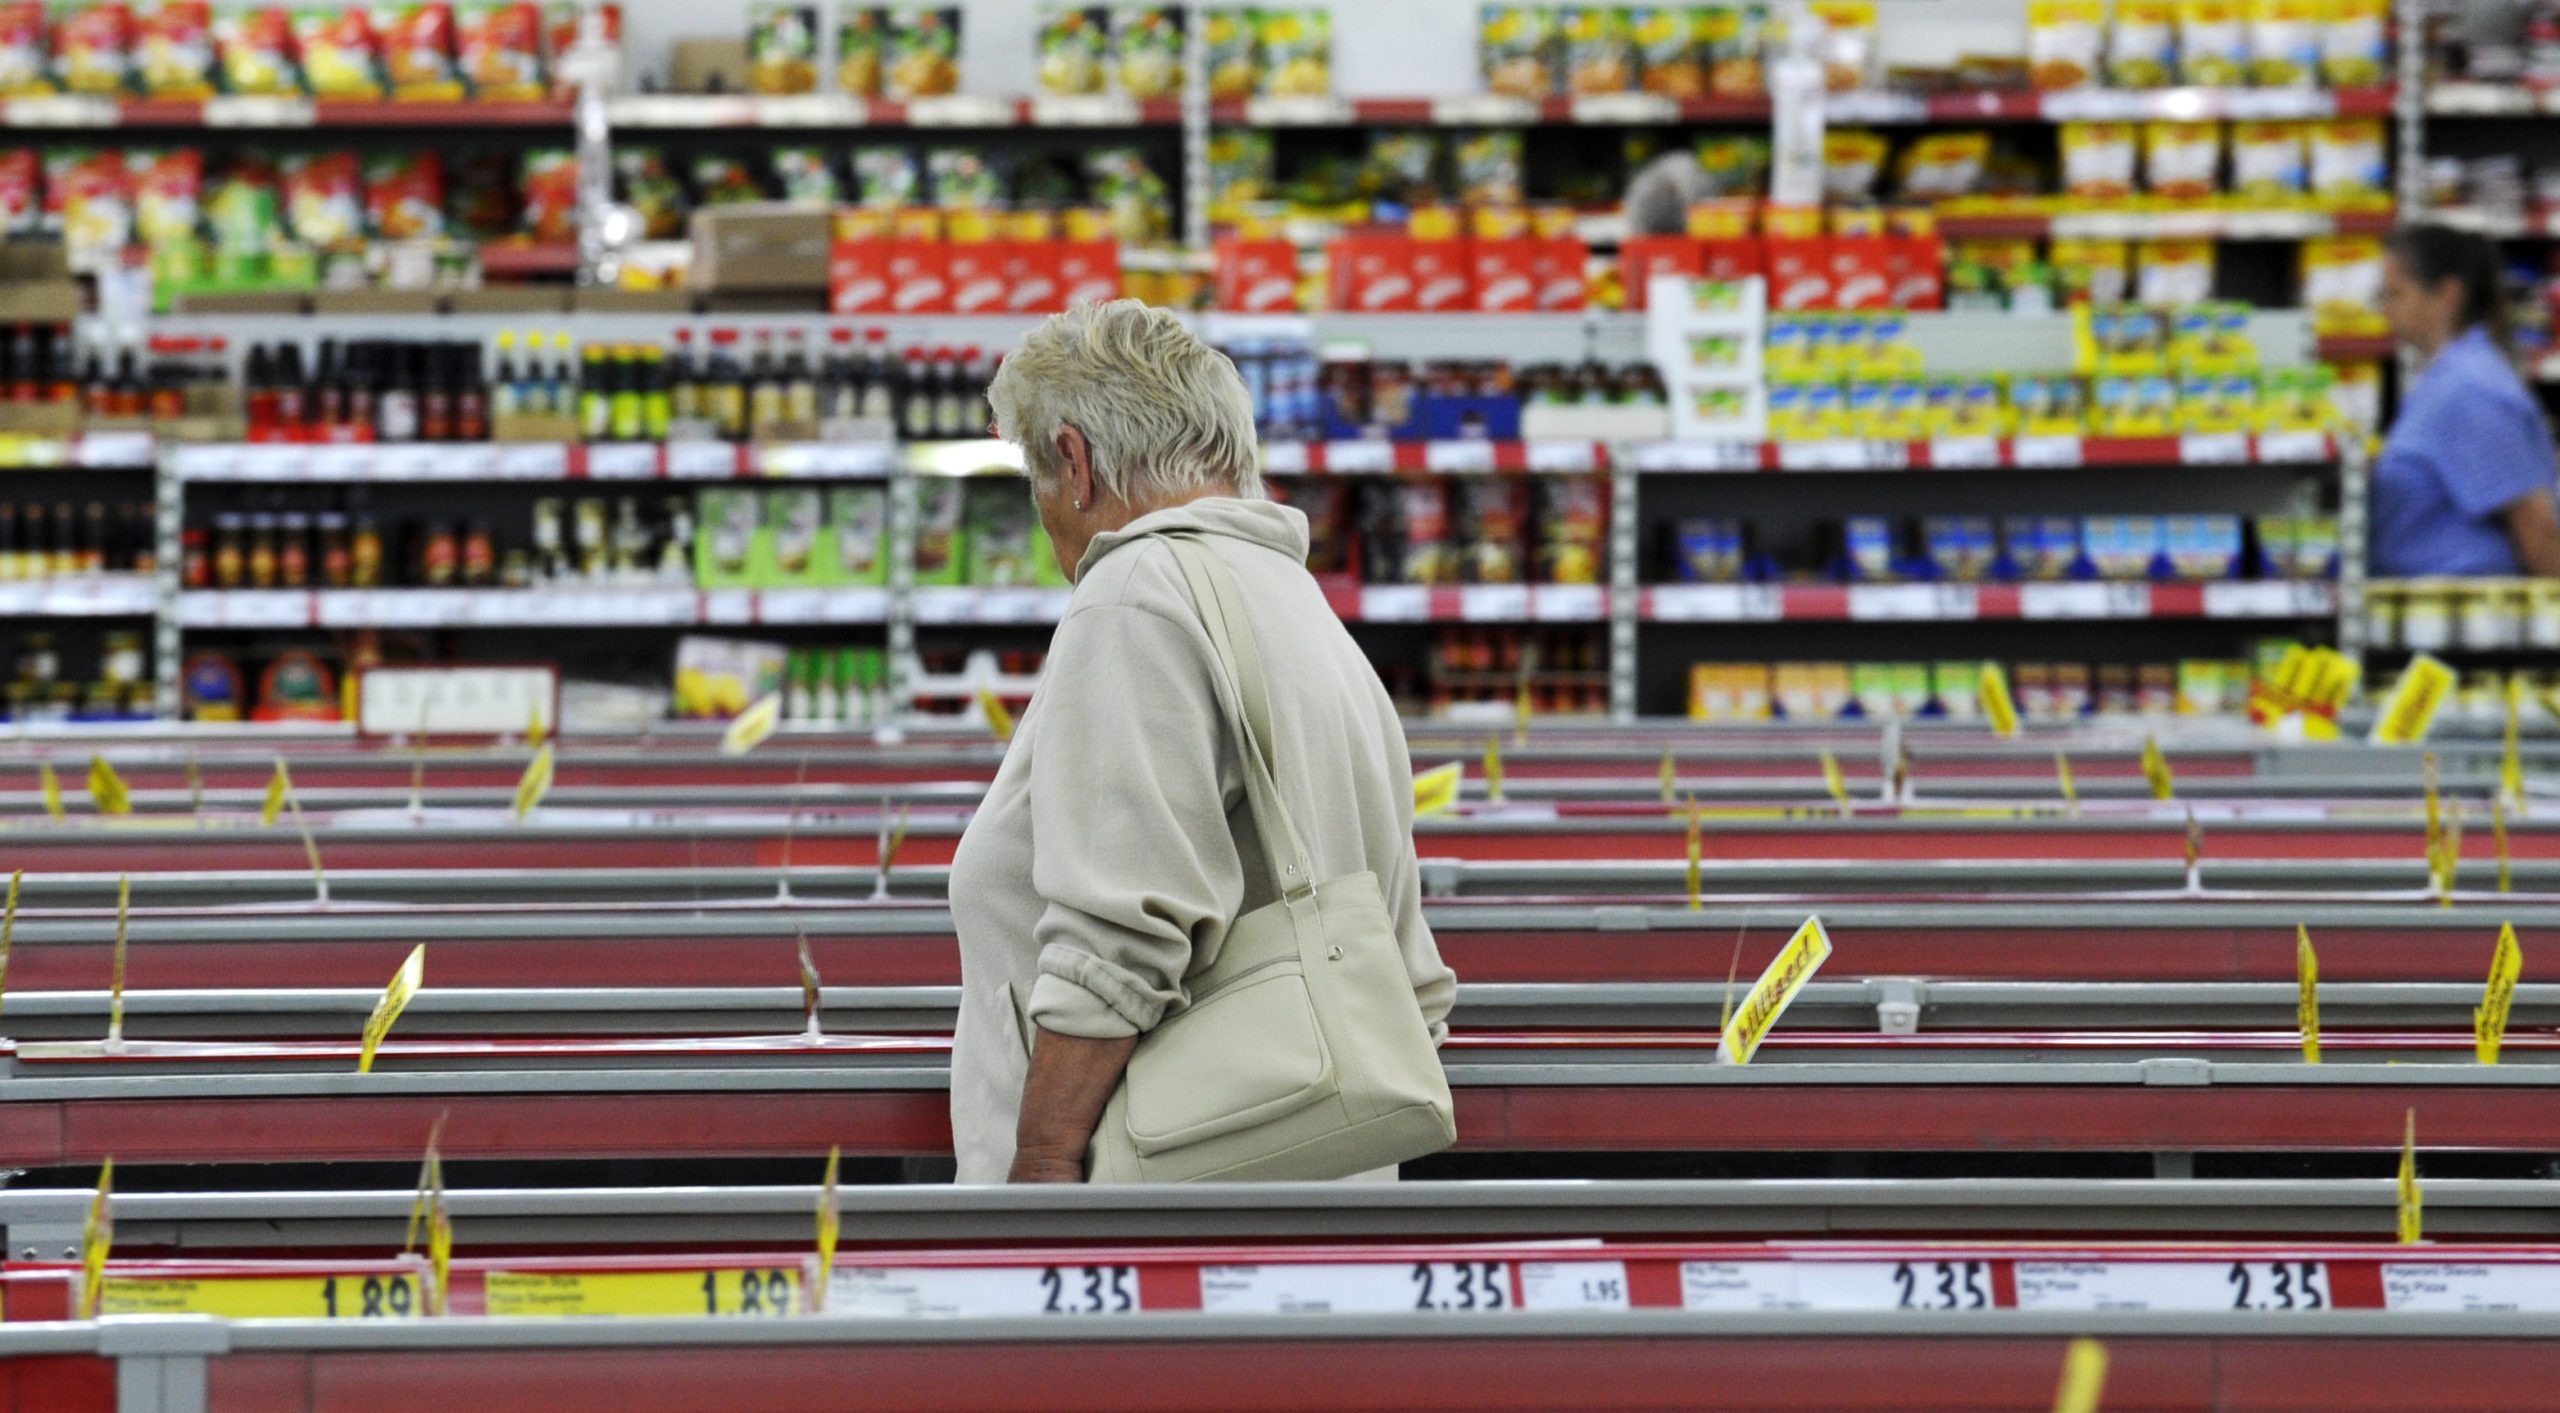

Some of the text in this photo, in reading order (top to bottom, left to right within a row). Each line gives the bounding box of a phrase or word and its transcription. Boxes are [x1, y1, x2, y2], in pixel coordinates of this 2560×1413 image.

[322, 1274, 412, 1317] 189
[1041, 1266, 1131, 1312] 2.35
[1412, 1263, 1502, 1310] 2.35
[1894, 1262, 1985, 1309] 2.35
[2228, 1262, 2323, 1310] 2.35
